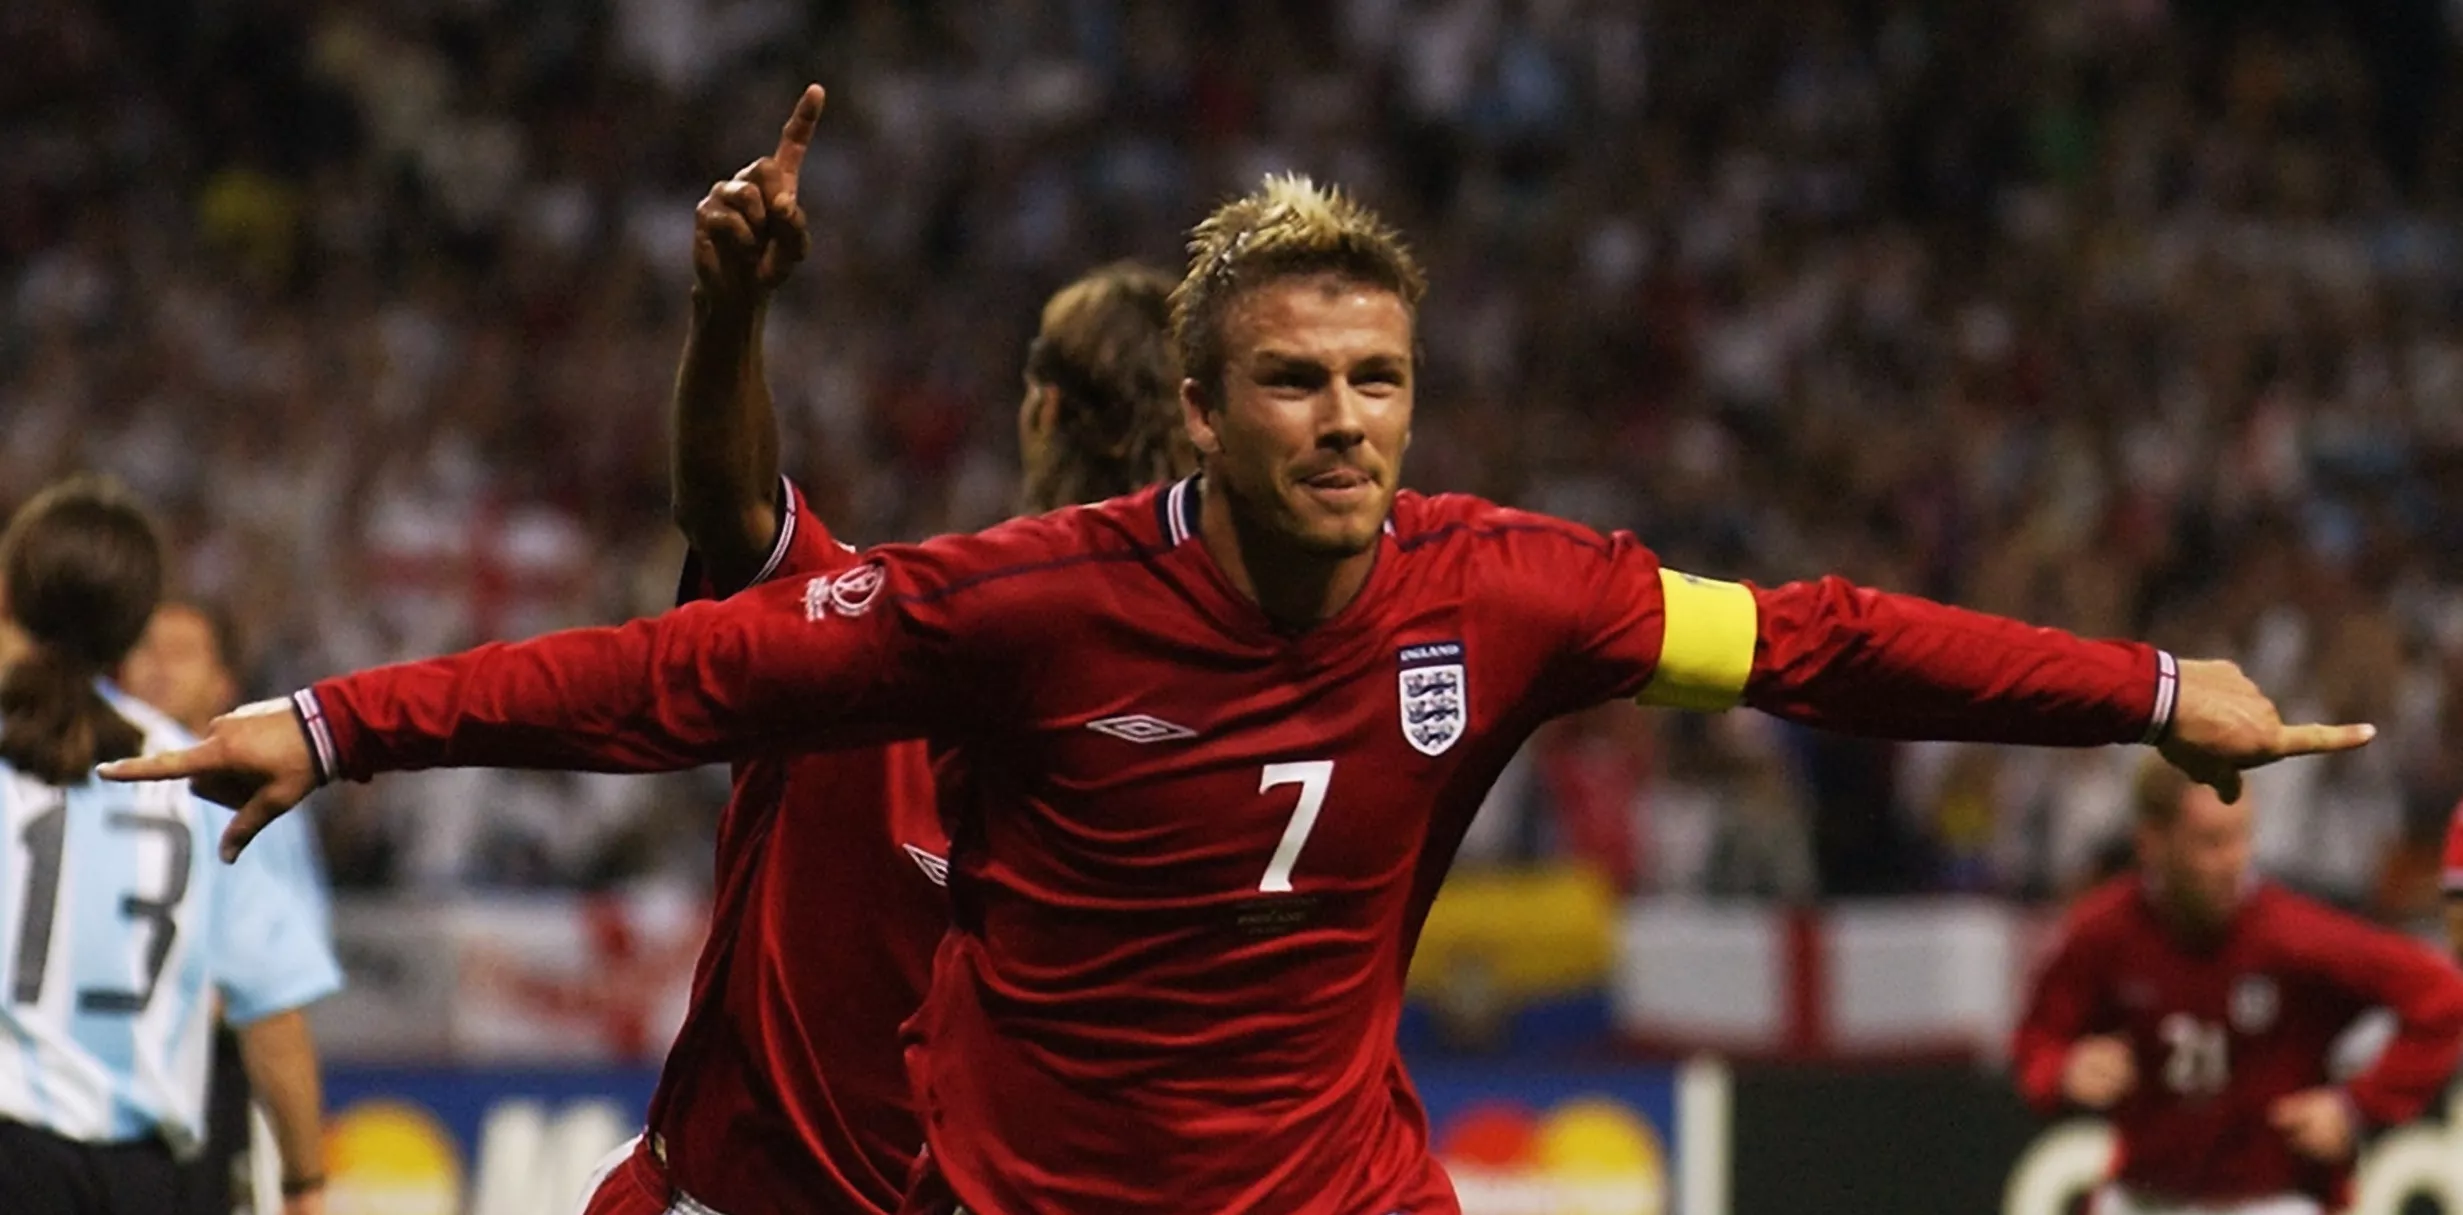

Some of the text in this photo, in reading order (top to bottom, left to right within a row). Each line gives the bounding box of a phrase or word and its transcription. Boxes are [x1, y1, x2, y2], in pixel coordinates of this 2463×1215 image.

[1401, 644, 1460, 662] ENGLAND
[1258, 760, 1334, 891] 7
[13, 804, 192, 1013] 13
[2157, 1012, 2231, 1095] 21
